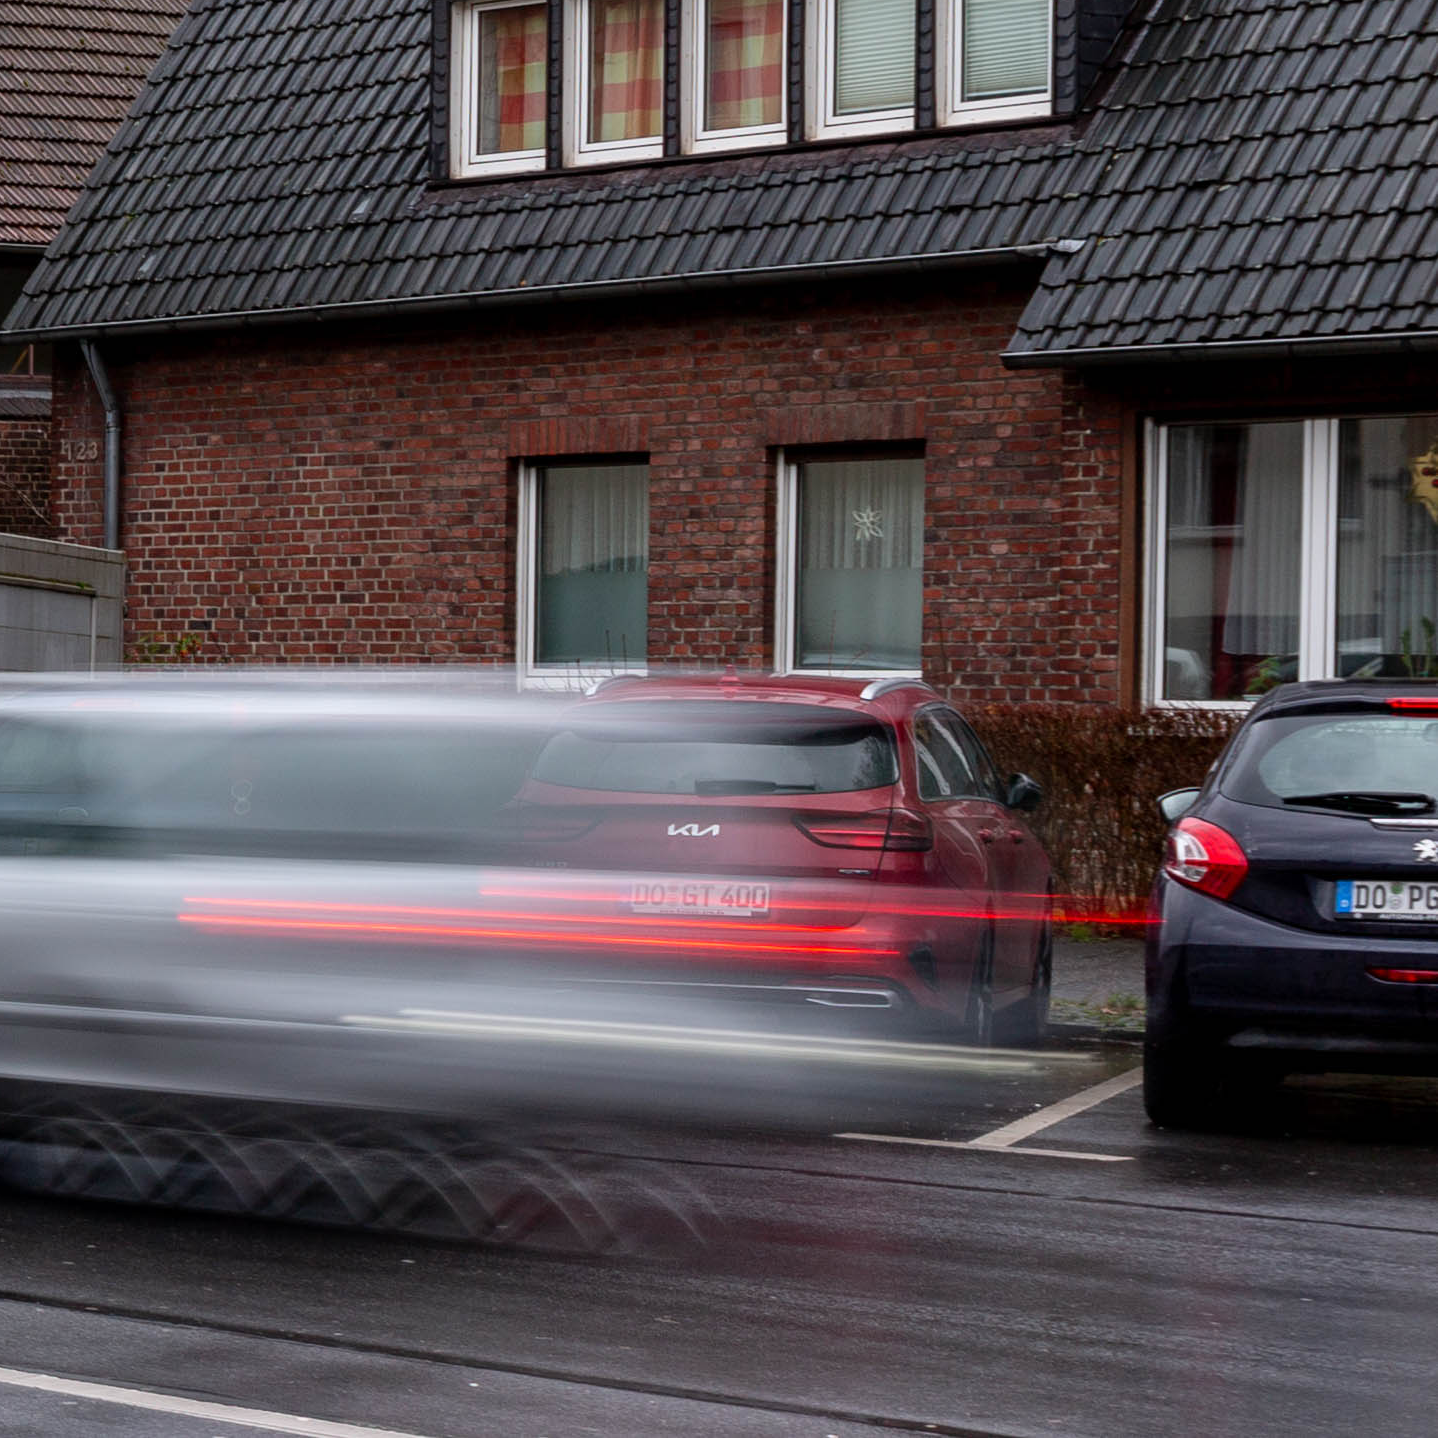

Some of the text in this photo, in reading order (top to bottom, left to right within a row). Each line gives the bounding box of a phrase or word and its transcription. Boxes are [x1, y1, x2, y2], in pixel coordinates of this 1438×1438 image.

[634, 884, 766, 909] DO GT 400
[1356, 884, 1386, 909] DO
